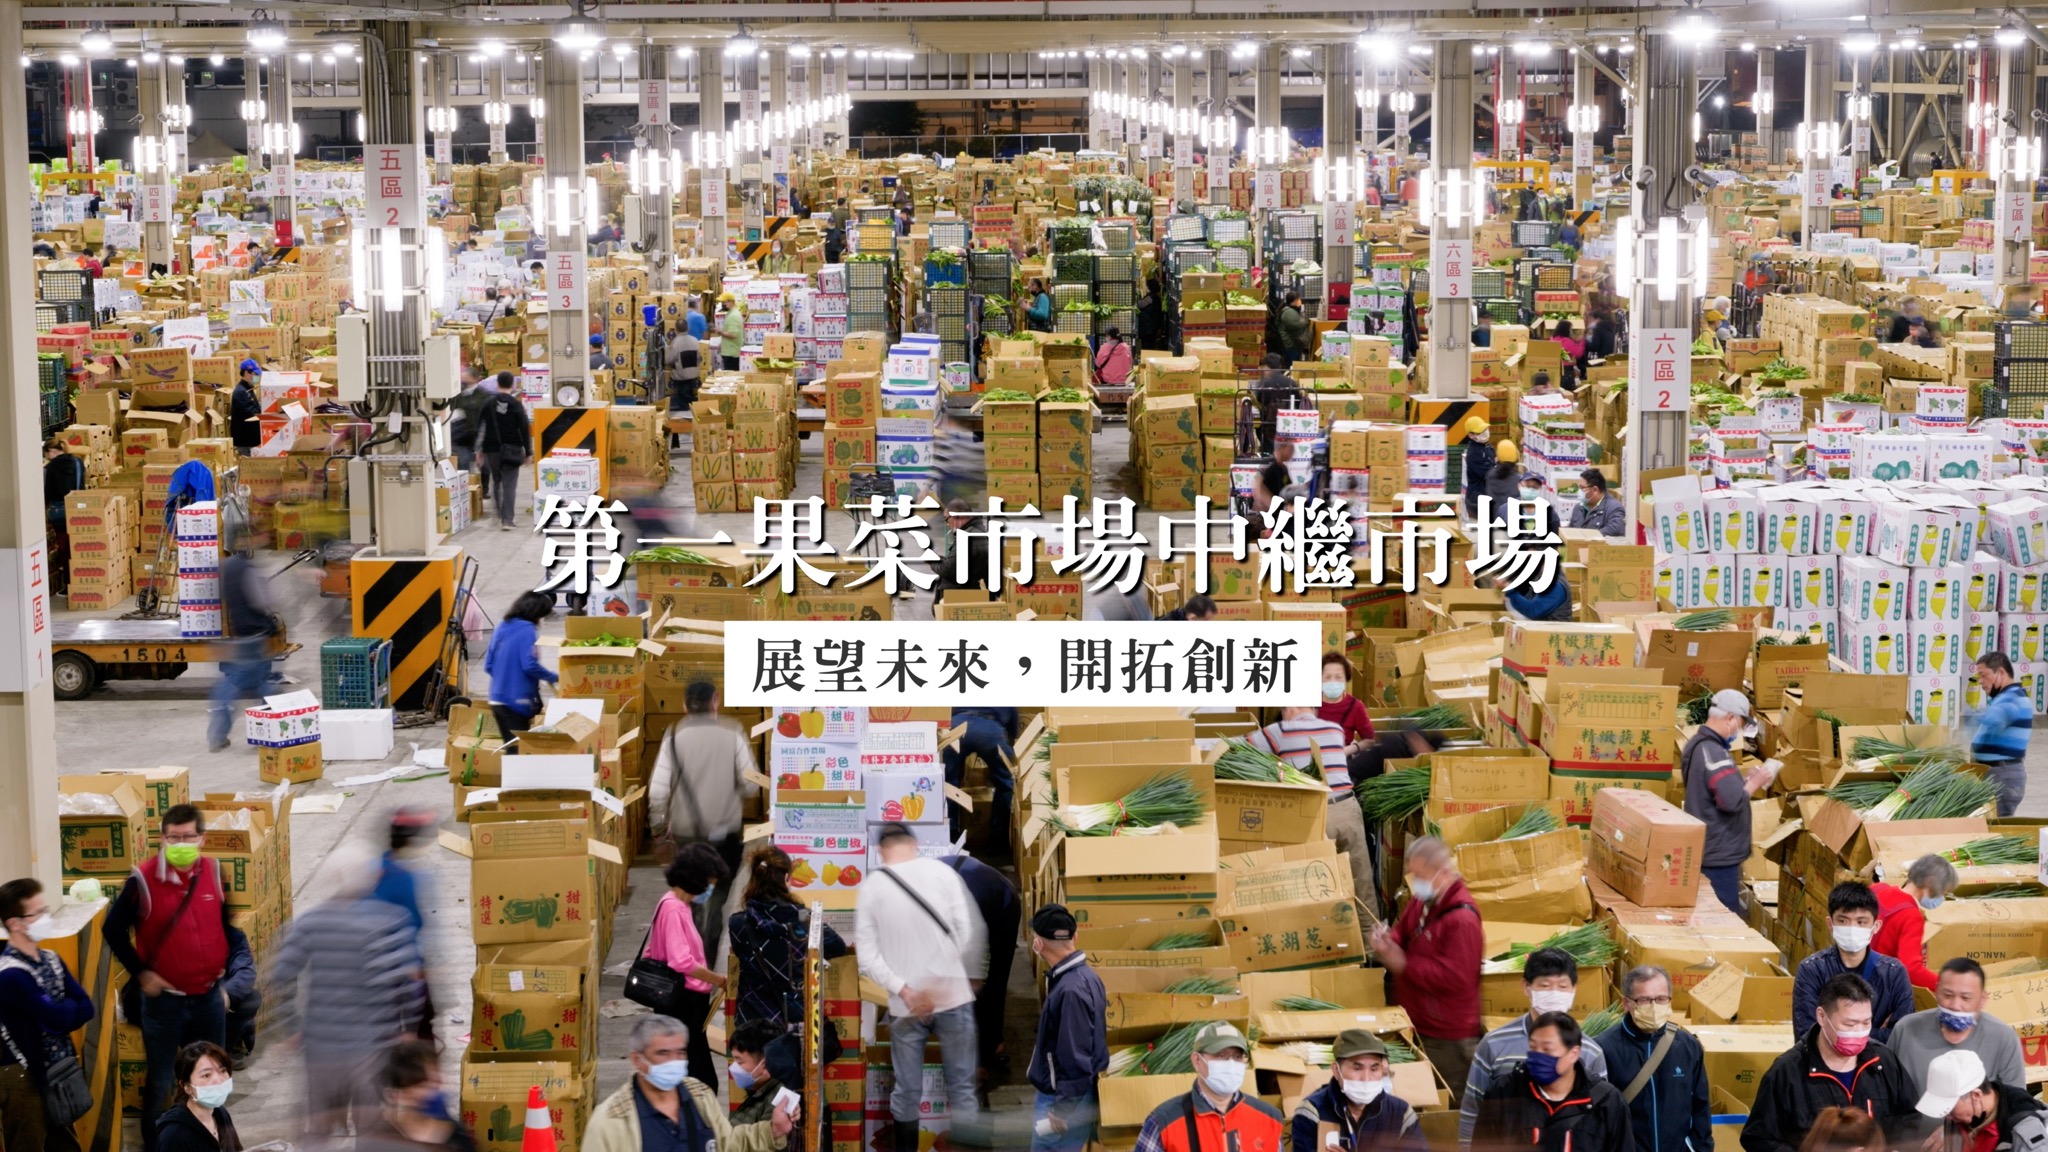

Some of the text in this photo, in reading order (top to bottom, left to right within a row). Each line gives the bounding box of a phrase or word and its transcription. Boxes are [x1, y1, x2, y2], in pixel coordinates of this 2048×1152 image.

[647, 83, 660, 124] 五區4
[746, 92, 754, 120] 五區6
[1179, 142, 1187, 167] 六區7
[1580, 143, 1588, 167] 七區7
[277, 168, 286, 196] 四區6
[379, 148, 402, 226] 五區2
[1213, 159, 1223, 187] 六區6
[150, 187, 159, 221] 四區5
[708, 182, 718, 217] 五區5
[1261, 173, 1275, 208] 六區5
[1814, 172, 1825, 207] 七區5
[1334, 204, 1347, 245] 六區4
[557, 255, 573, 308] 五區3
[1447, 243, 1461, 297] 六區3
[1654, 335, 1676, 410] 六區2
[30, 550, 44, 678] 五區1
[123, 648, 186, 661] 1504
[1549, 633, 1615, 650] 精緻蔬菜
[832, 711, 856, 722] 甜椒
[1582, 727, 1654, 746] 精緻蔬菜
[831, 769, 856, 781] 甜椒
[812, 836, 861, 849] 彩色甜椒
[479, 895, 493, 926] 特選
[565, 890, 582, 922] 甜椒
[1966, 950, 2007, 959] NANLON
[481, 1003, 495, 1047] 特選
[561, 1005, 579, 1049] 甜椒
